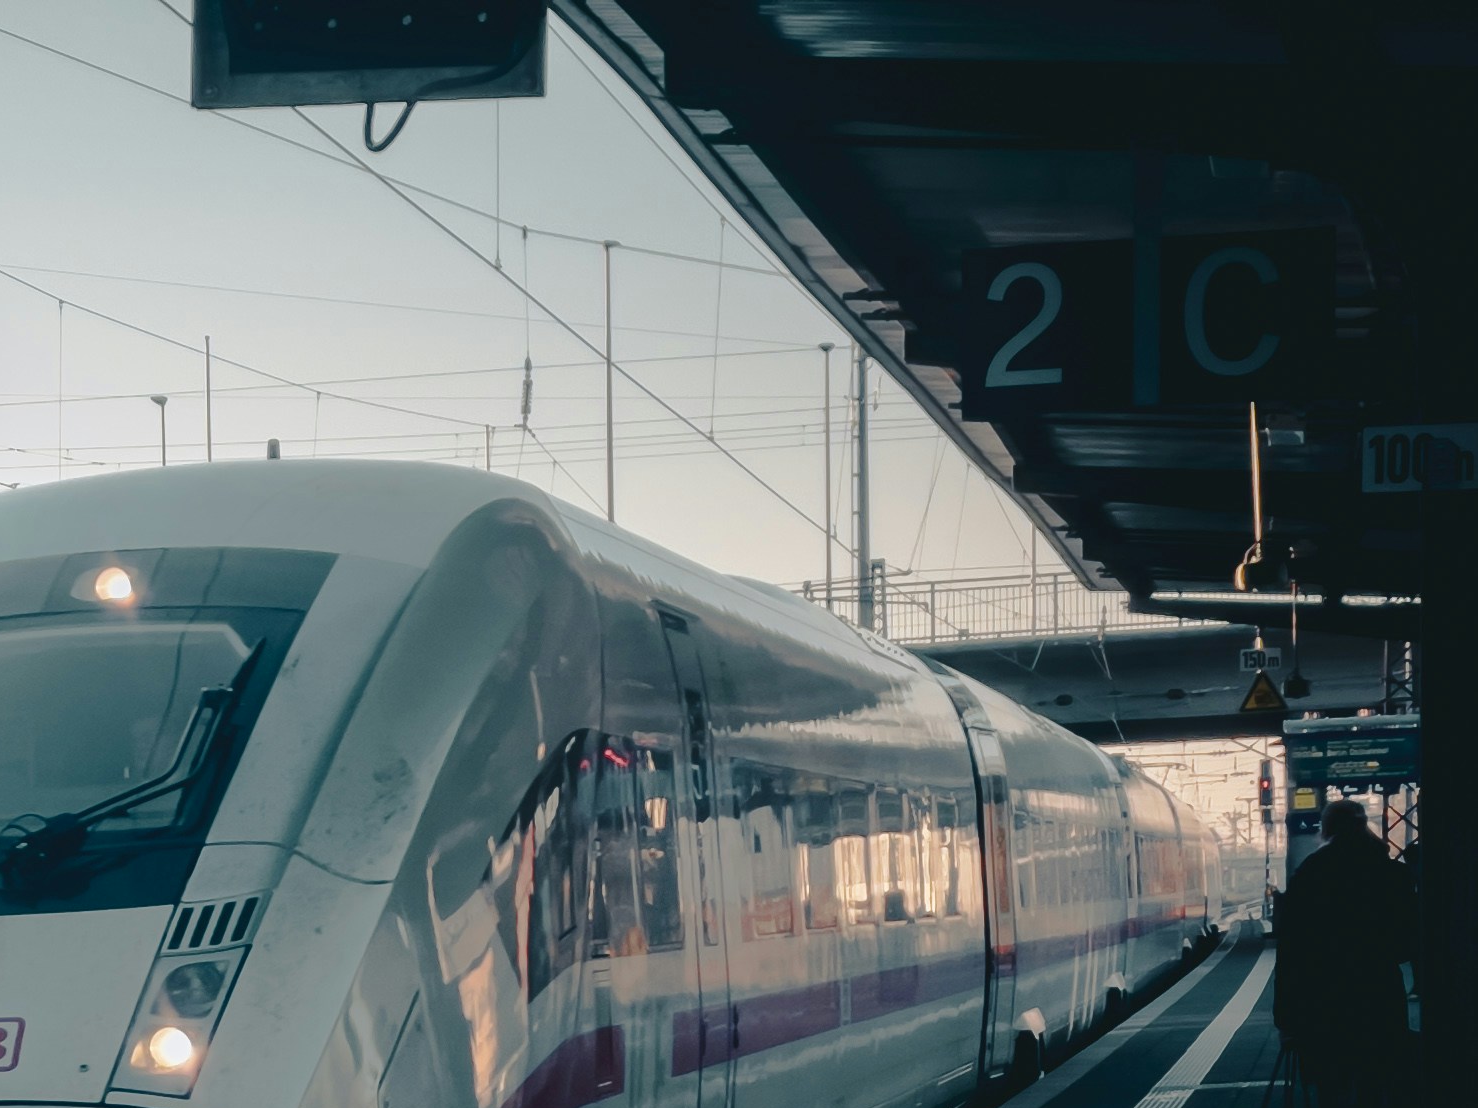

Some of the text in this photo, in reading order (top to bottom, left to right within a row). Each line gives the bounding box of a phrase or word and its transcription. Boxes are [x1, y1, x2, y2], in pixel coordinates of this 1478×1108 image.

[985, 247, 1280, 388] 2 C
[1242, 651, 1280, 668] 150 m
